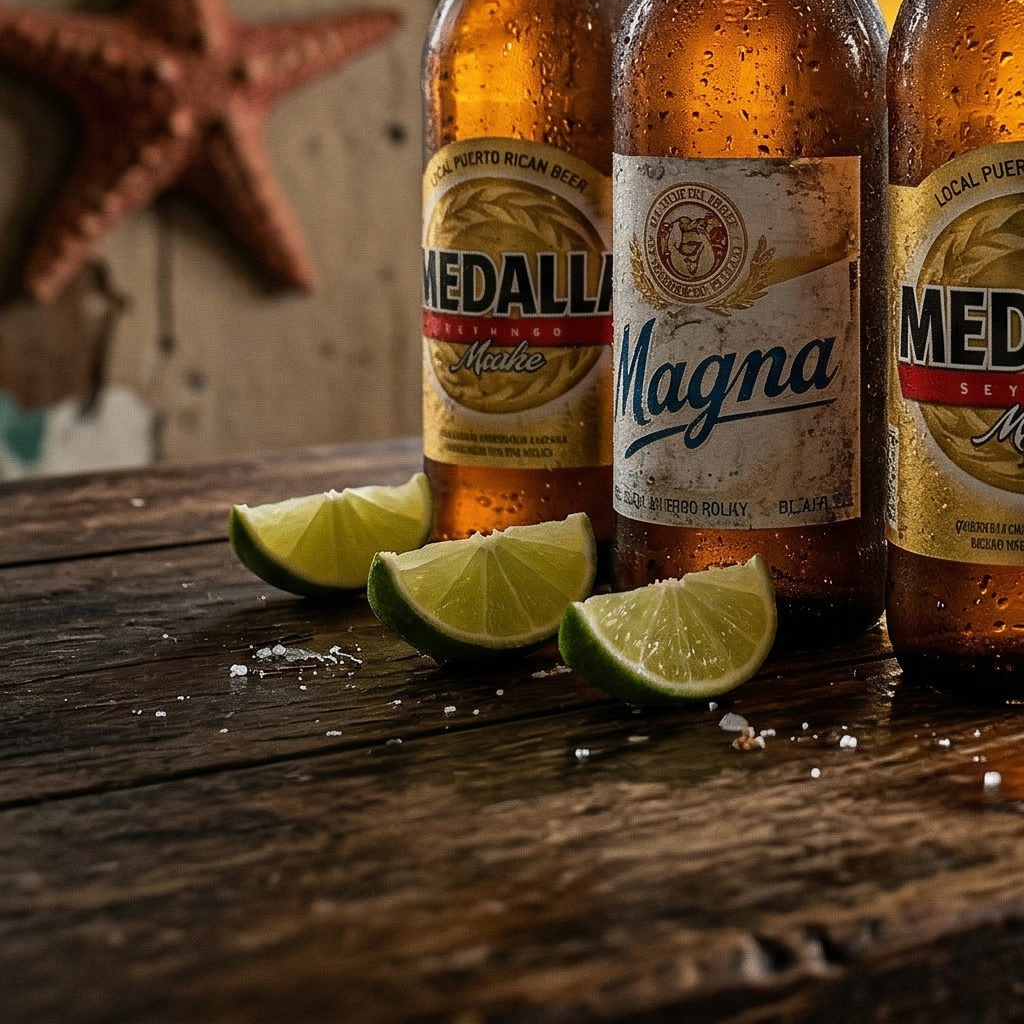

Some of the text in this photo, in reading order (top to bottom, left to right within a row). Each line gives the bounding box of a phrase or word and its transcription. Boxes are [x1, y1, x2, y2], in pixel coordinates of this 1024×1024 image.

[454, 151, 500, 169] PUERTO
[504, 152, 549, 174] RICAN
[550, 164, 588, 193] BEER
[935, 172, 980, 207] LOCAL
[615, 317, 839, 449] Magna
